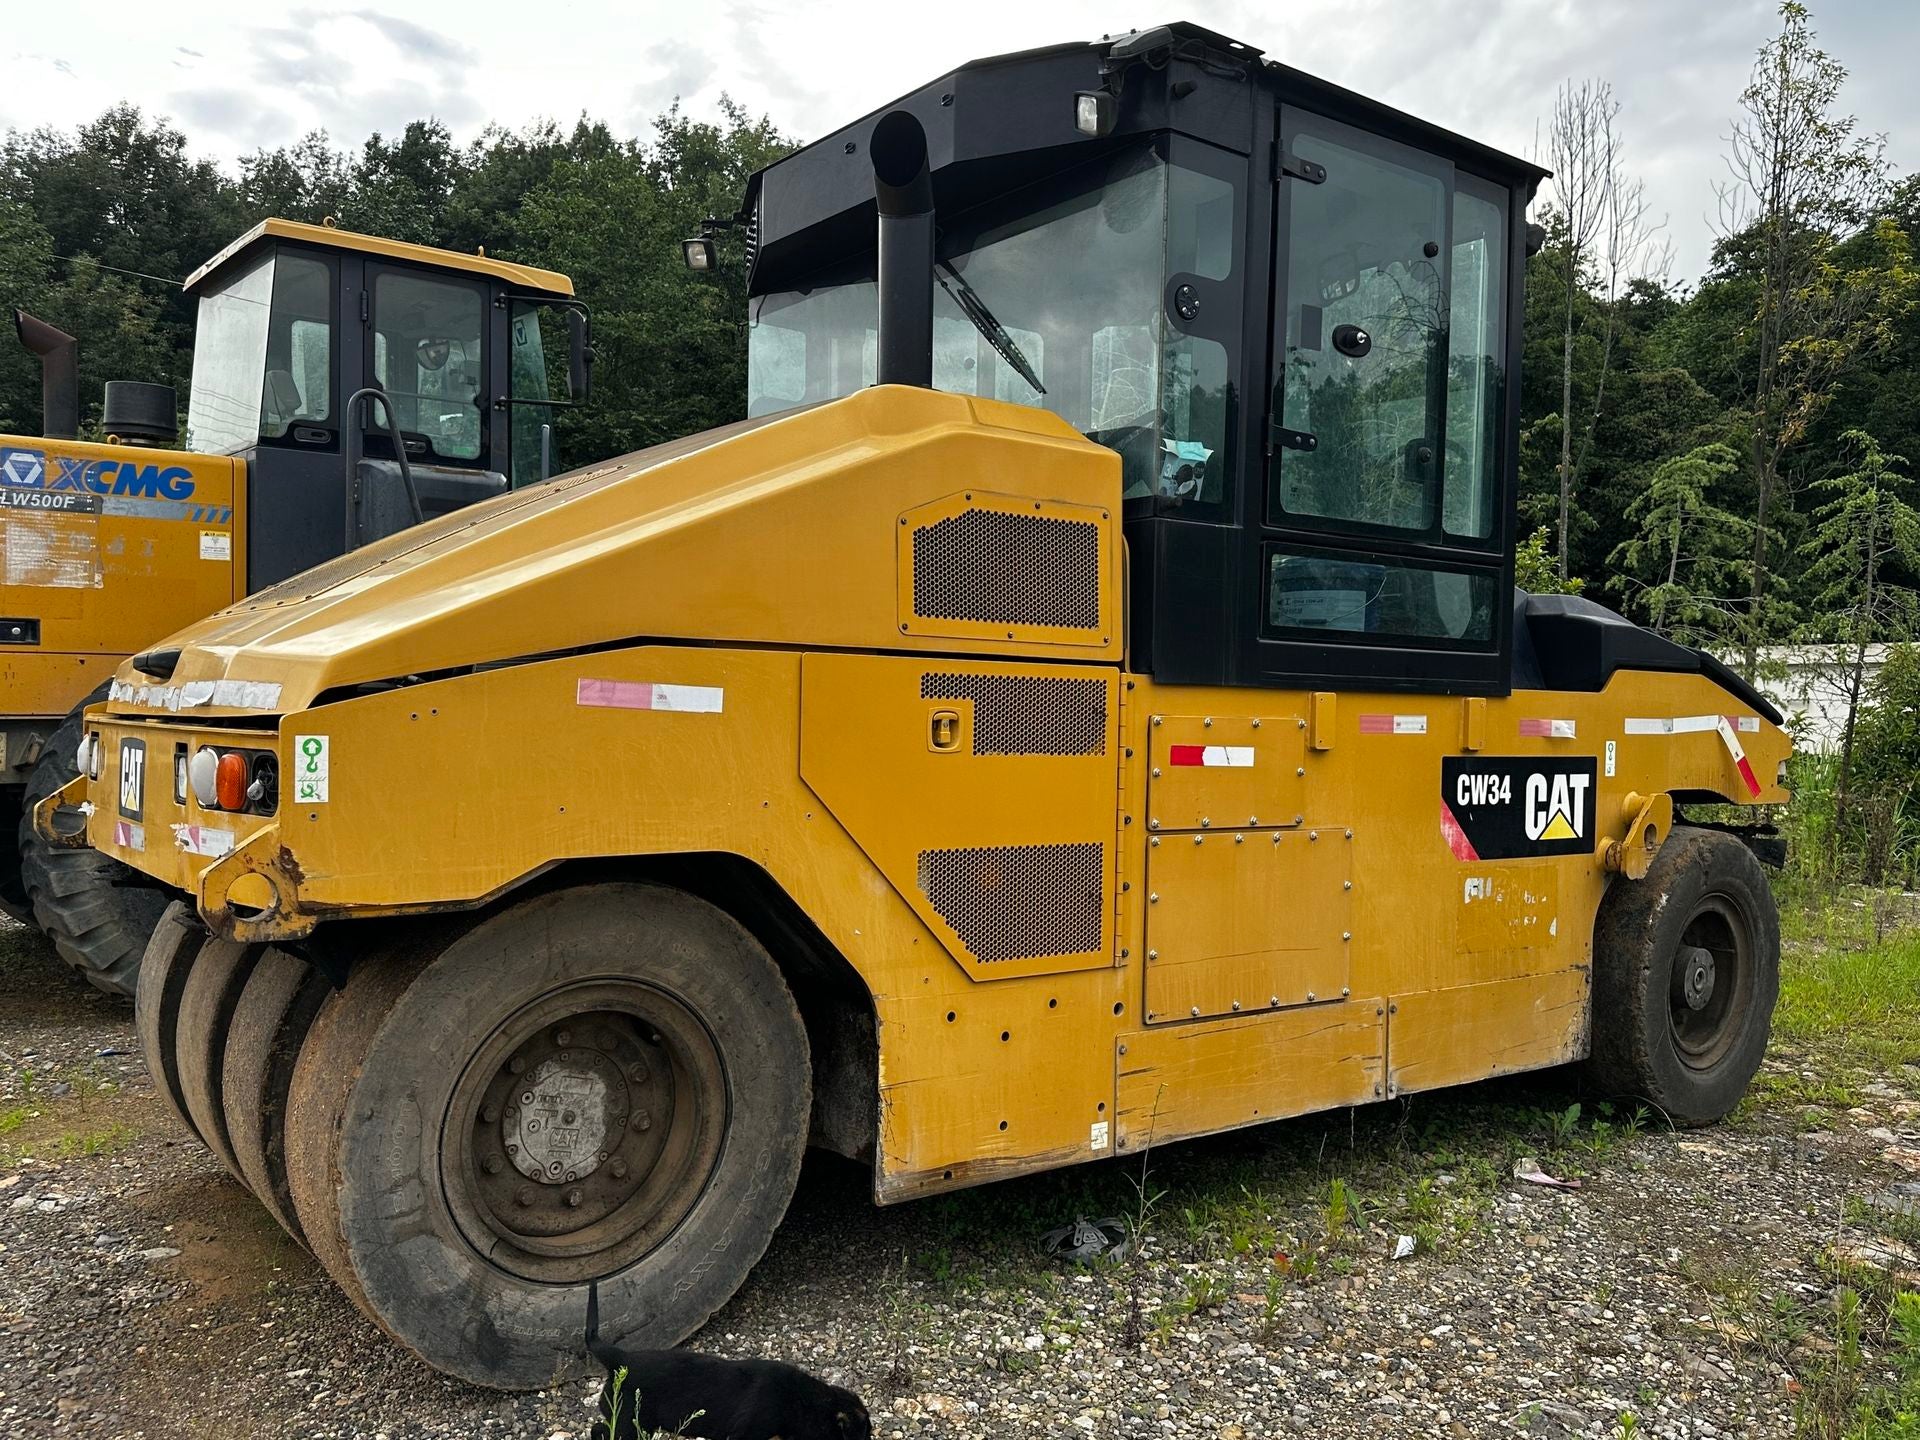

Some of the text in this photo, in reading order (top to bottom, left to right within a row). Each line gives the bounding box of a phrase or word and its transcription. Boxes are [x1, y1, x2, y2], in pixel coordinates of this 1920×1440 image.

[48, 457, 196, 501] XCMG
[0, 492, 76, 509] LW500F
[121, 746, 143, 811] CAT
[1457, 773, 1511, 806] CW34
[1525, 773, 1590, 841] CAT
[549, 1127, 580, 1149] CAT
